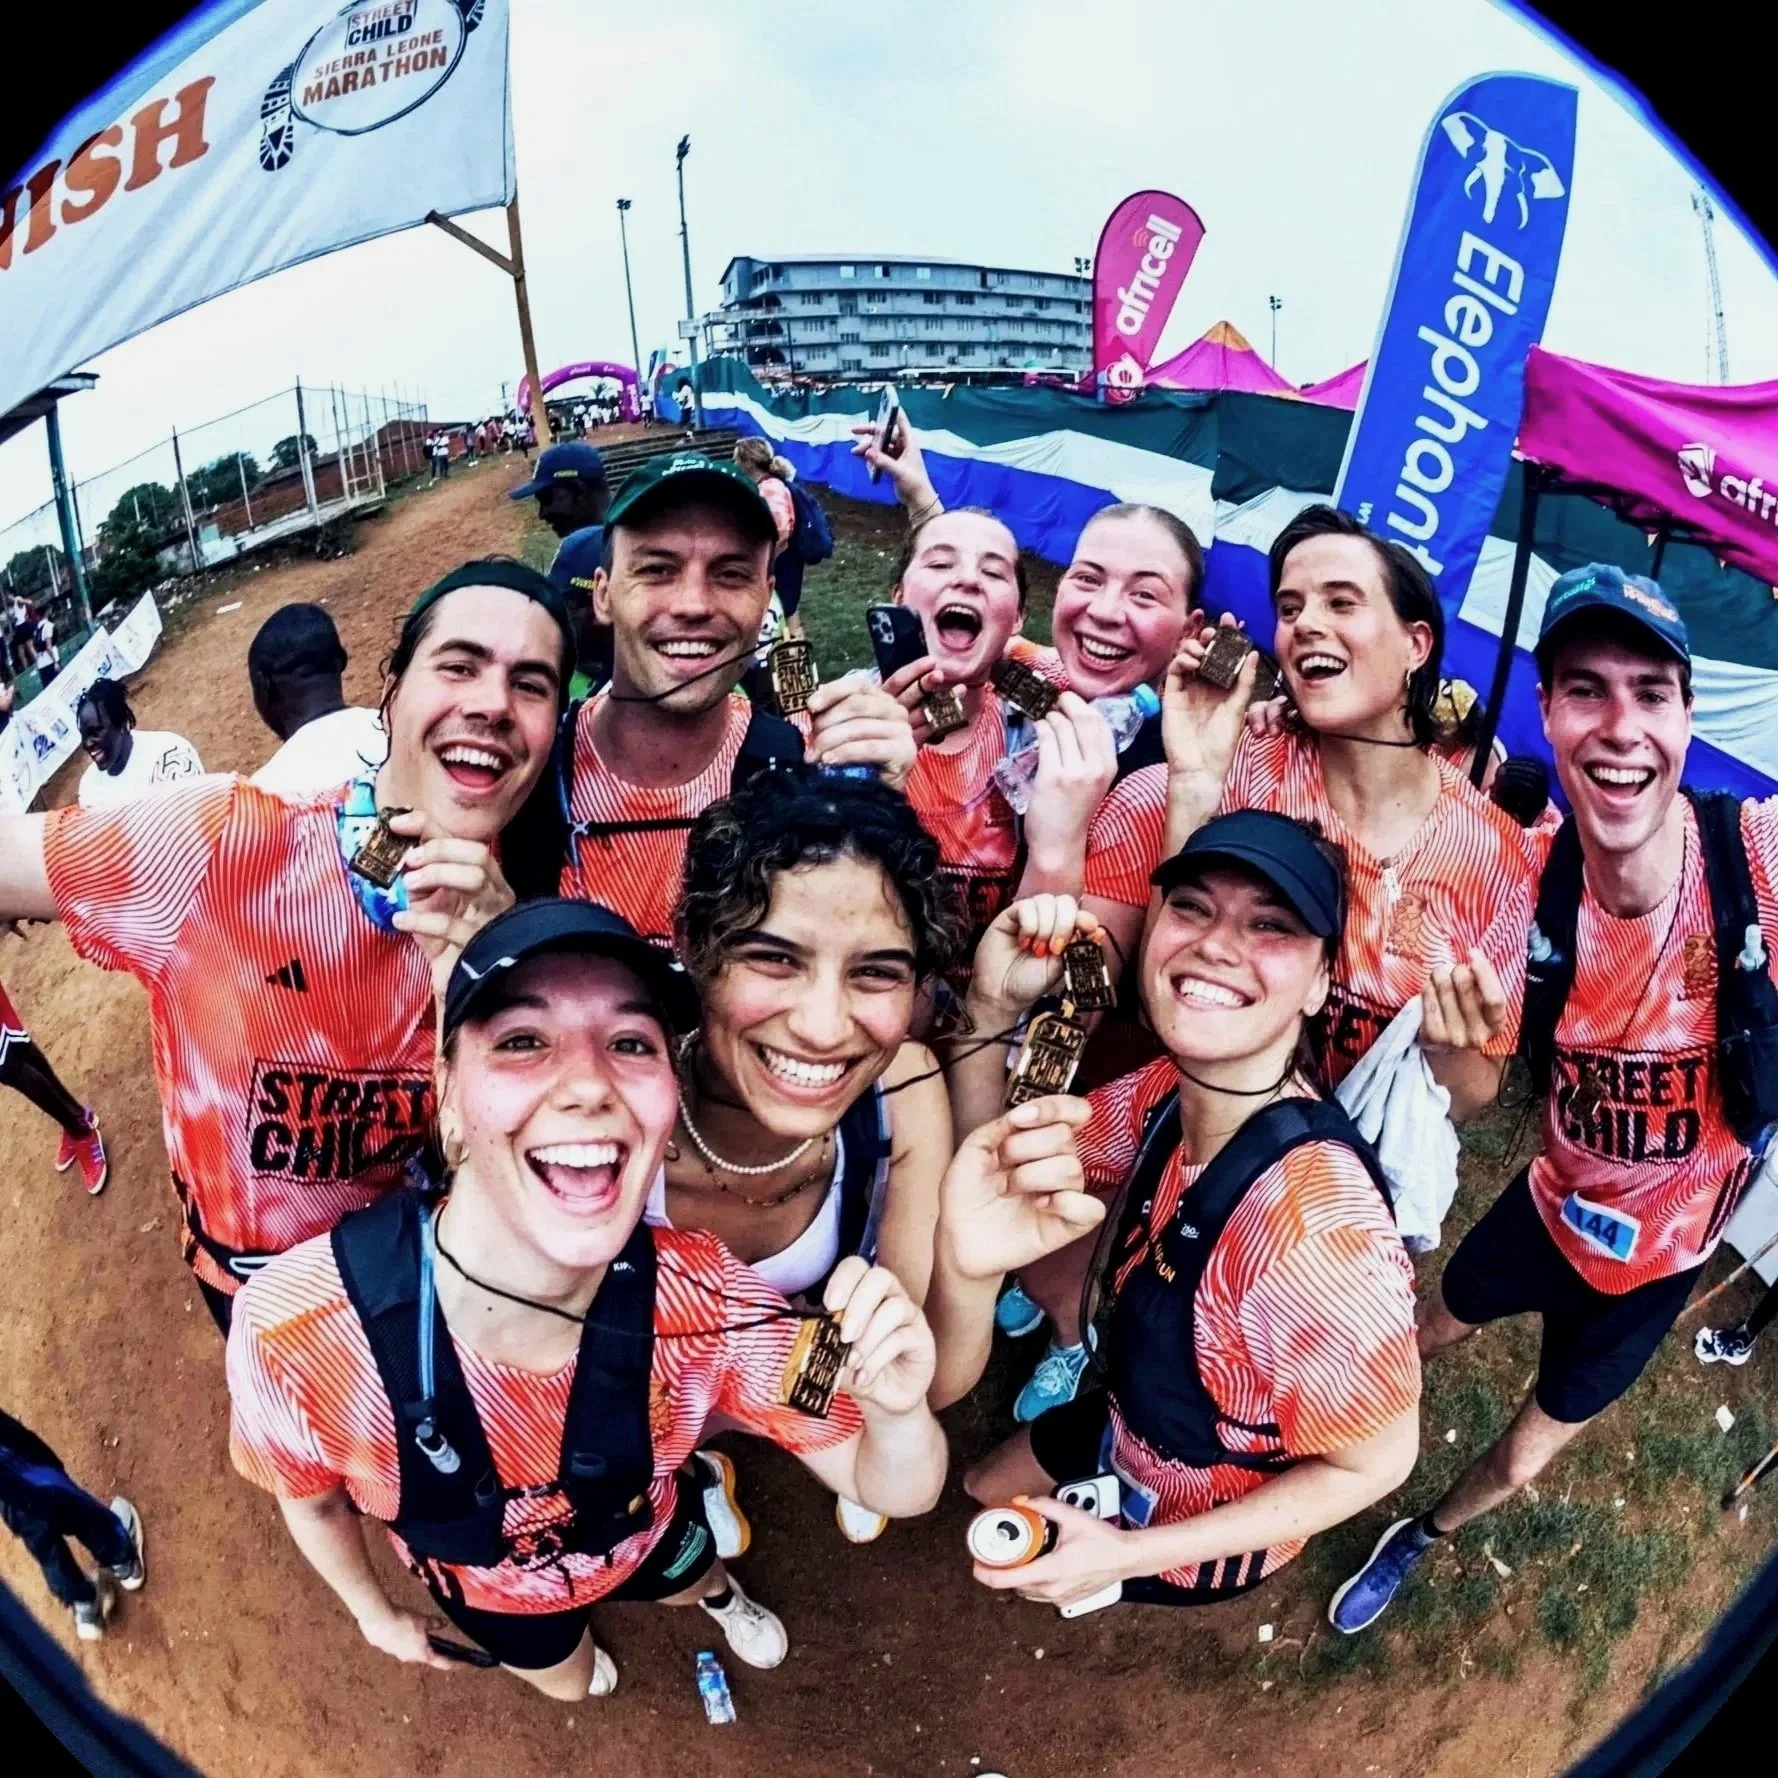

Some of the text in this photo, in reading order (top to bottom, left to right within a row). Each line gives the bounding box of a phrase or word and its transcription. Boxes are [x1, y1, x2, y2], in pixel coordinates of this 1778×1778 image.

[349, 14, 412, 46] CHILD
[351, 0, 414, 29] STREET
[302, 46, 447, 106] MARATHON
[315, 29, 443, 79] SIERRA LEONE
[1116, 213, 1183, 336] africell
[1387, 231, 1525, 577] Elephant
[1720, 475, 1778, 526] afr
